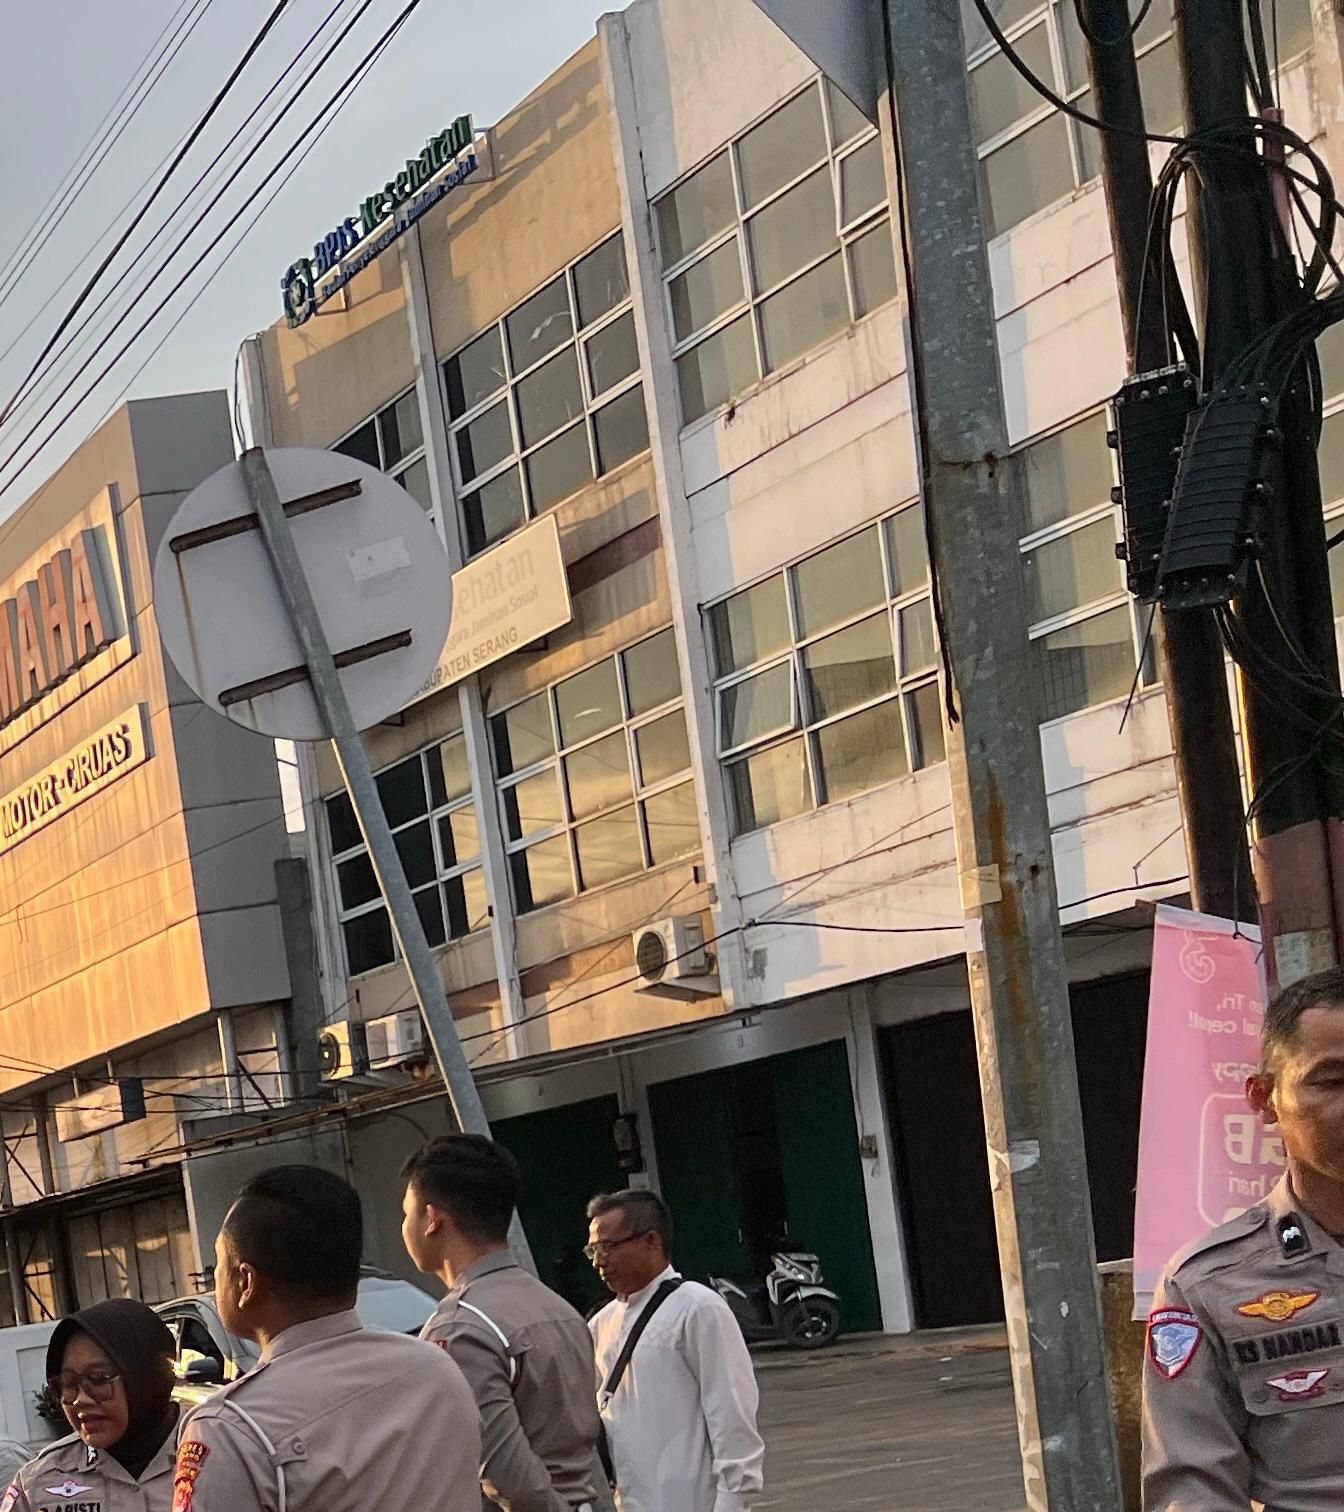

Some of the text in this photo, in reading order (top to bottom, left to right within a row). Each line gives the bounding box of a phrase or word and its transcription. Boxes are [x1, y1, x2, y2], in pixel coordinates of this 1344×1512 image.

[313, 114, 472, 271] BPJS Kesehatan
[473, 627, 519, 664] SERANG
